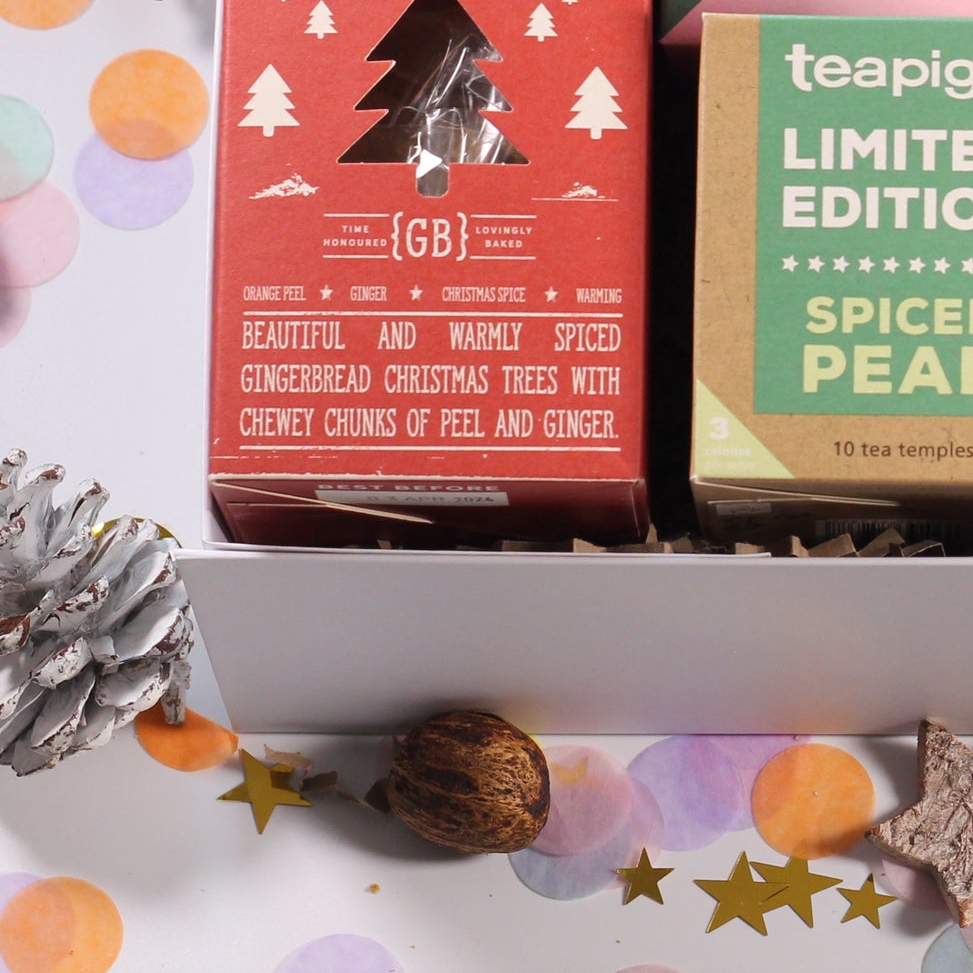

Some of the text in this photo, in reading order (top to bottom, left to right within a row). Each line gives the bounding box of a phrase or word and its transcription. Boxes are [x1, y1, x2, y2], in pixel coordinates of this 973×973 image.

[342, 225, 369, 234] TIME
[476, 227, 532, 235] LOVINGLY
[322, 238, 388, 247] HONOURED
[485, 239, 523, 249] BAKED
[243, 285, 306, 301] ORANGE PEEL
[350, 286, 387, 302] GINGER
[442, 286, 526, 303] CHRISTMAS SPICE
[576, 287, 622, 304] WARMING
[242, 321, 621, 351] BEAUTIFUL AND WARMLY SPICED
[240, 364, 620, 395] GINGERBREAD CHRISTMAS TREES WITH
[239, 408, 314, 437] CHEWEY
[324, 408, 396, 437] CHUNKS
[406, 409, 431, 437] OF
[440, 409, 486, 438] PEEL
[494, 409, 534, 438] AND
[708, 416, 730, 441] 3
[833, 440, 973, 463] 10 tea temples
